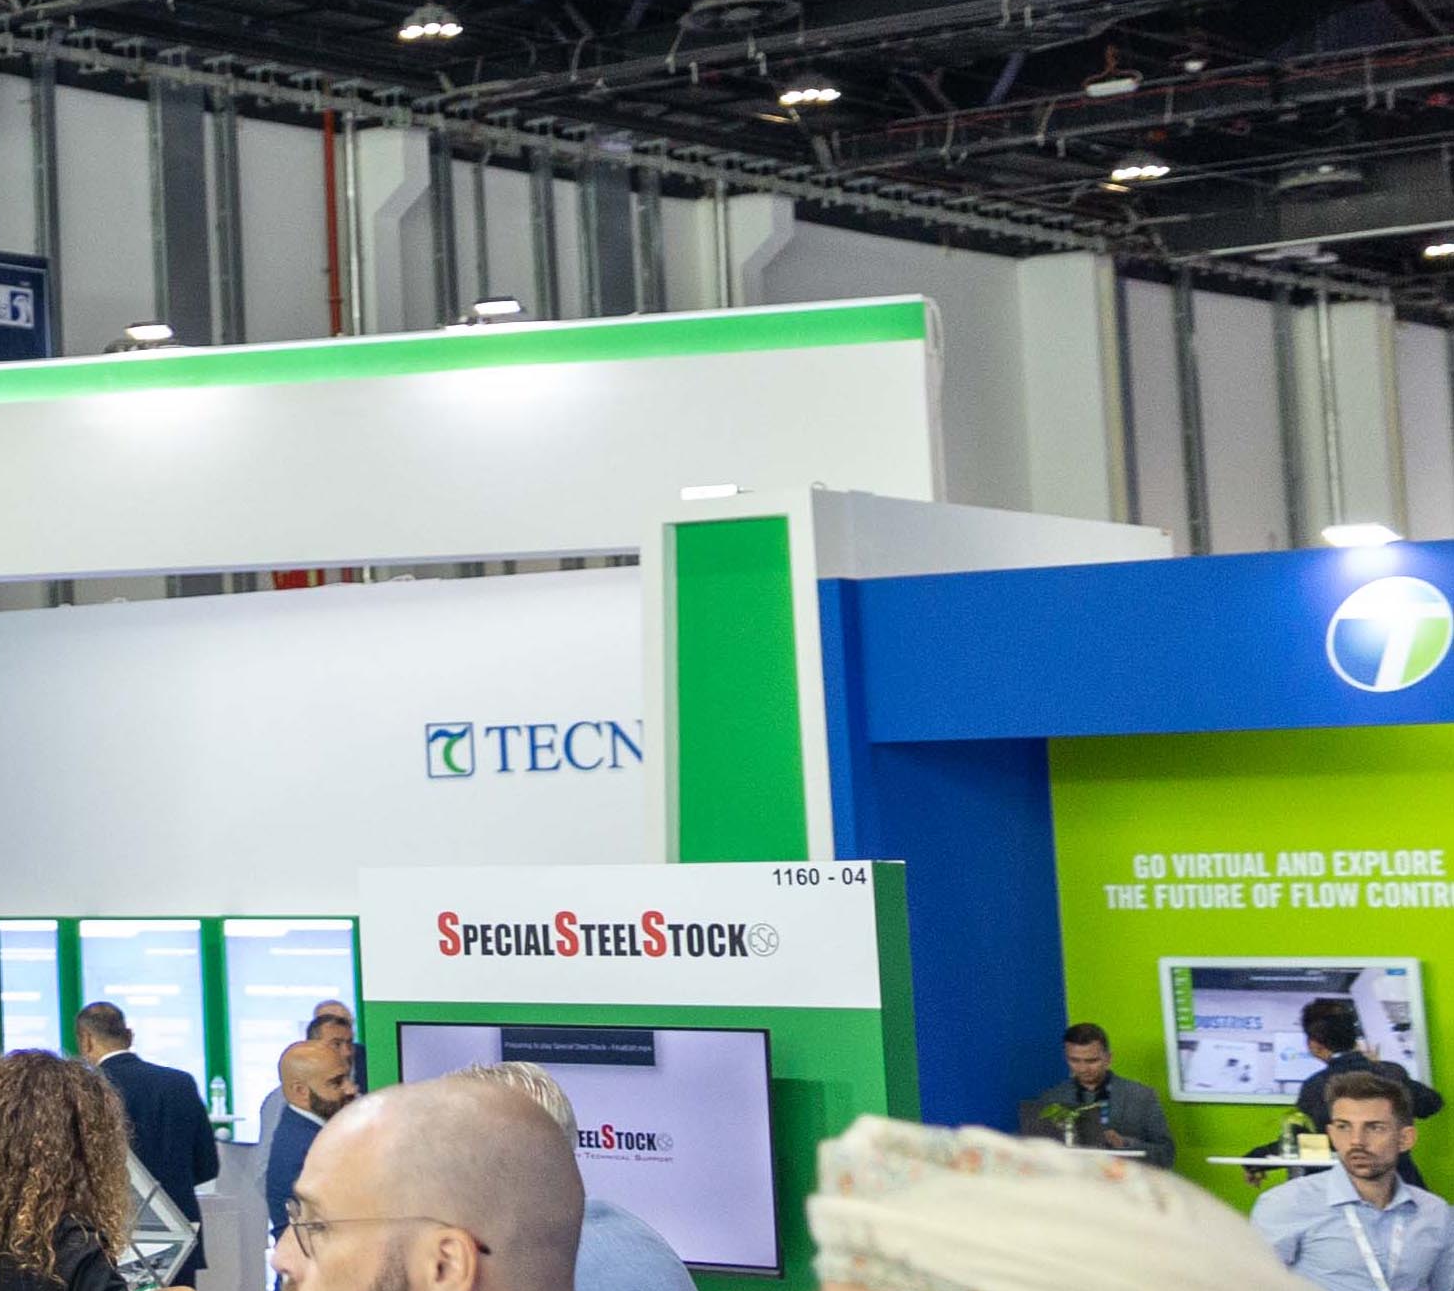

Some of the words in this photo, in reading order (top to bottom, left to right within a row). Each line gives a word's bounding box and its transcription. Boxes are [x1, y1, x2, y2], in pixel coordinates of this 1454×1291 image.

[772, 868, 820, 886] 1160
[842, 868, 867, 885] 04
[1133, 854, 1167, 879] GO
[1171, 853, 1271, 878] VIRTUAL
[1276, 852, 1327, 877] AND
[1332, 850, 1446, 877] EXPLORE
[1104, 885, 1147, 909] THE
[1154, 884, 1246, 908] FUTURE
[1252, 883, 1283, 908] OF
[1291, 883, 1360, 908] FLOW
[1365, 882, 1454, 908] CONTR
